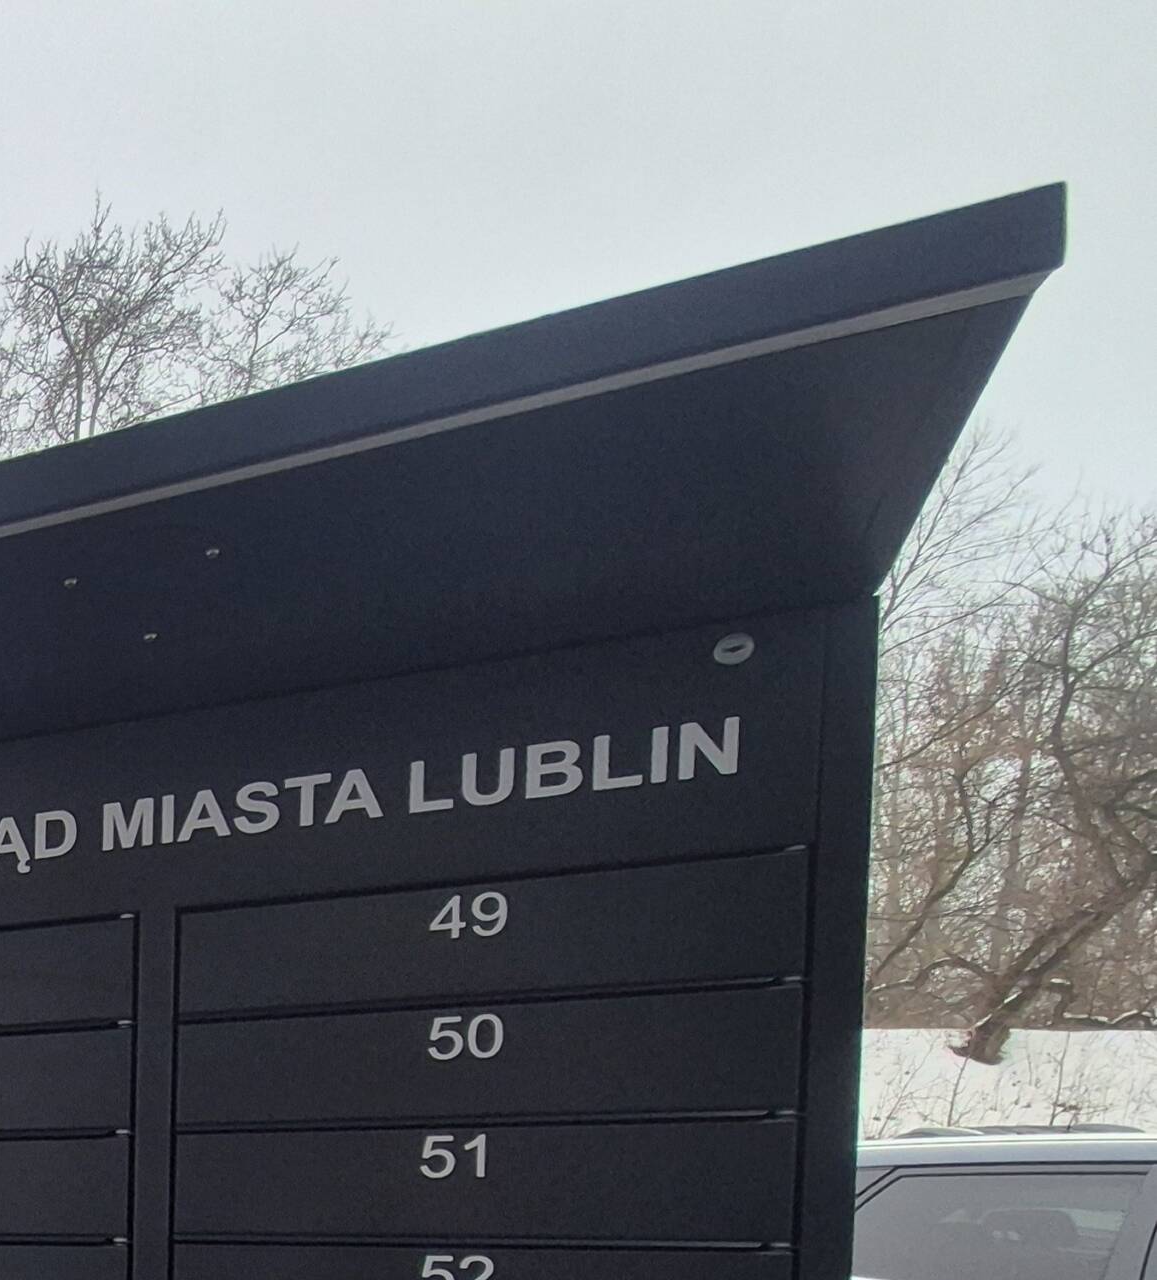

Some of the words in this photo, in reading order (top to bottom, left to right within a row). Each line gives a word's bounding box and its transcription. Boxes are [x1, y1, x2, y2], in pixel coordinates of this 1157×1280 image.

[101, 769, 383, 852] MIASTA
[407, 716, 741, 814] LUBLIN
[429, 891, 508, 939] 49
[428, 1013, 503, 1060] 50
[420, 1133, 486, 1179] 51
